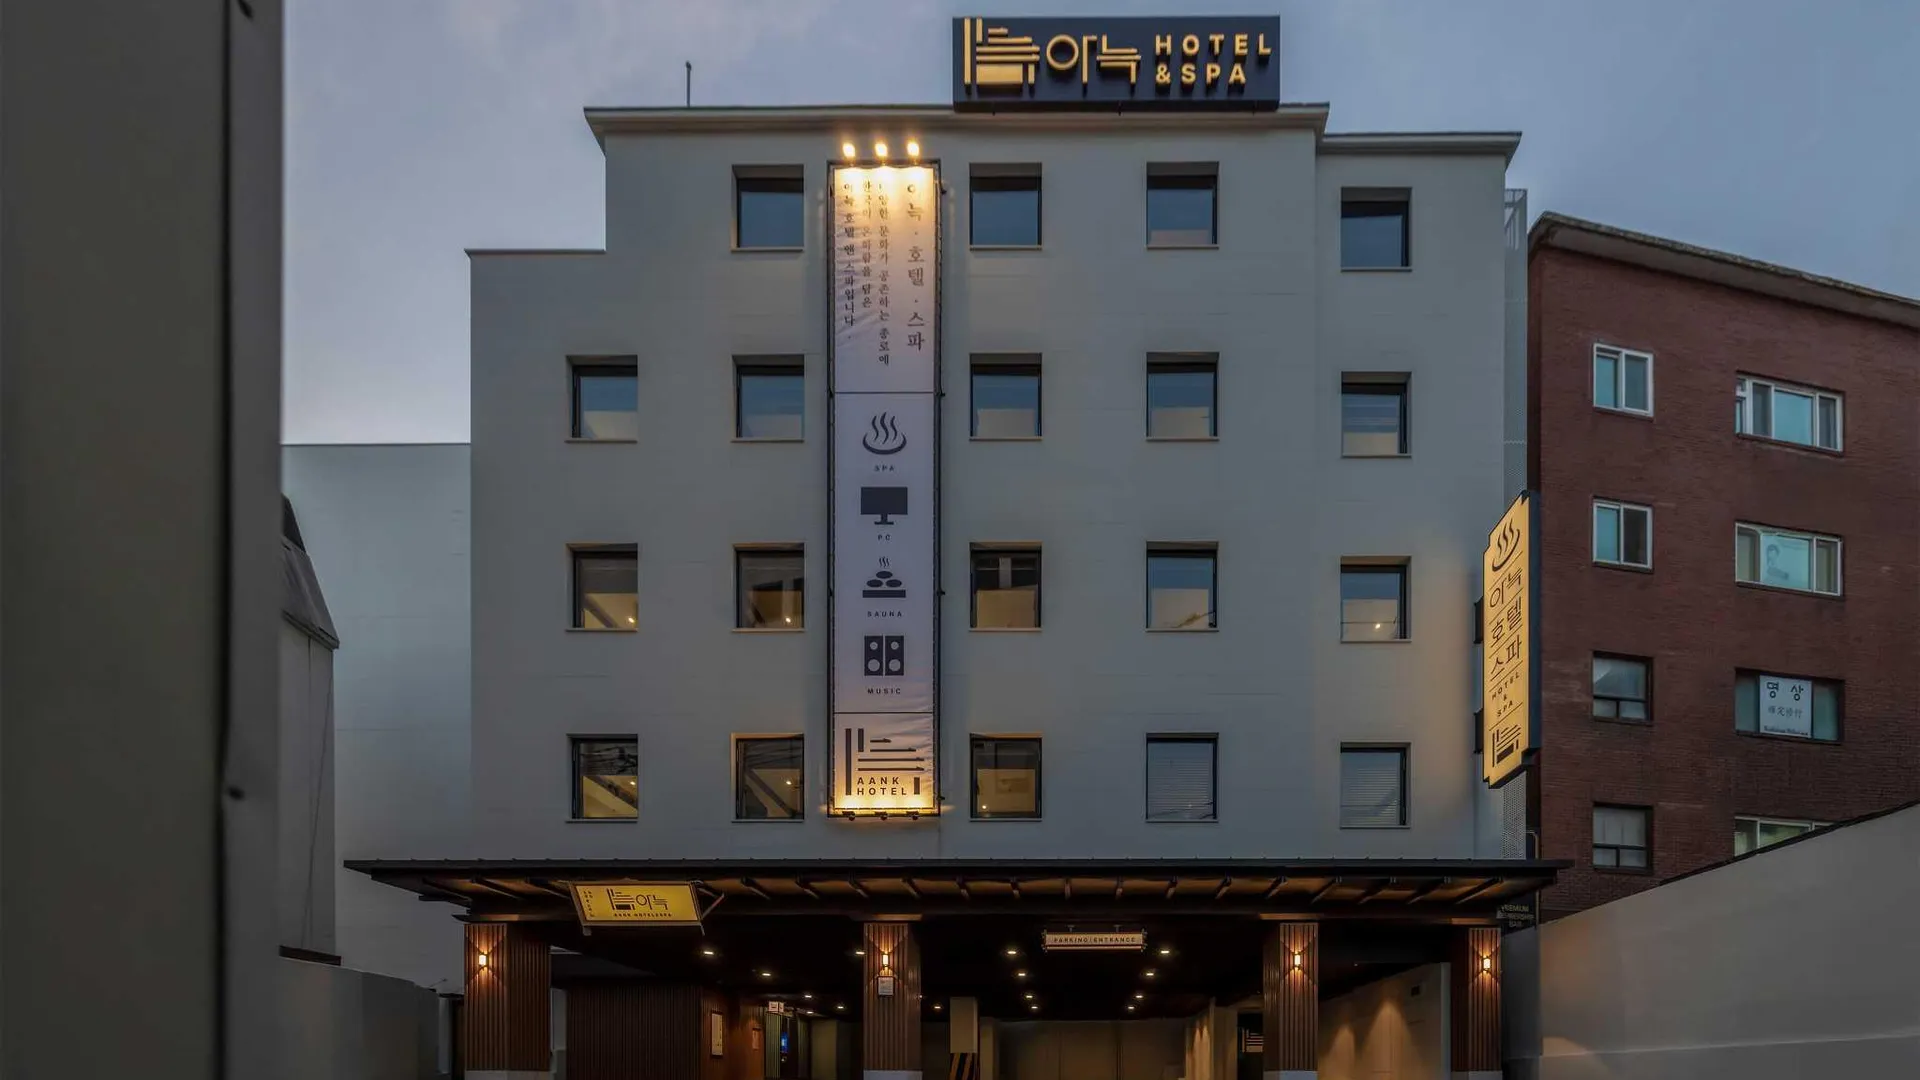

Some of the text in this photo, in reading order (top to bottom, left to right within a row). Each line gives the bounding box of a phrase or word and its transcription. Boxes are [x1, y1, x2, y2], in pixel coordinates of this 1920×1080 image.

[1155, 33, 1272, 56] HOTEL
[907, 312, 926, 351] 스파
[1490, 596, 1522, 648] 호텔
[1489, 634, 1522, 682] 스파
[1491, 671, 1520, 701] HOTEL
[1496, 699, 1514, 718] SPA
[857, 777, 900, 785] AANK
[857, 788, 908, 796] HOTEL
